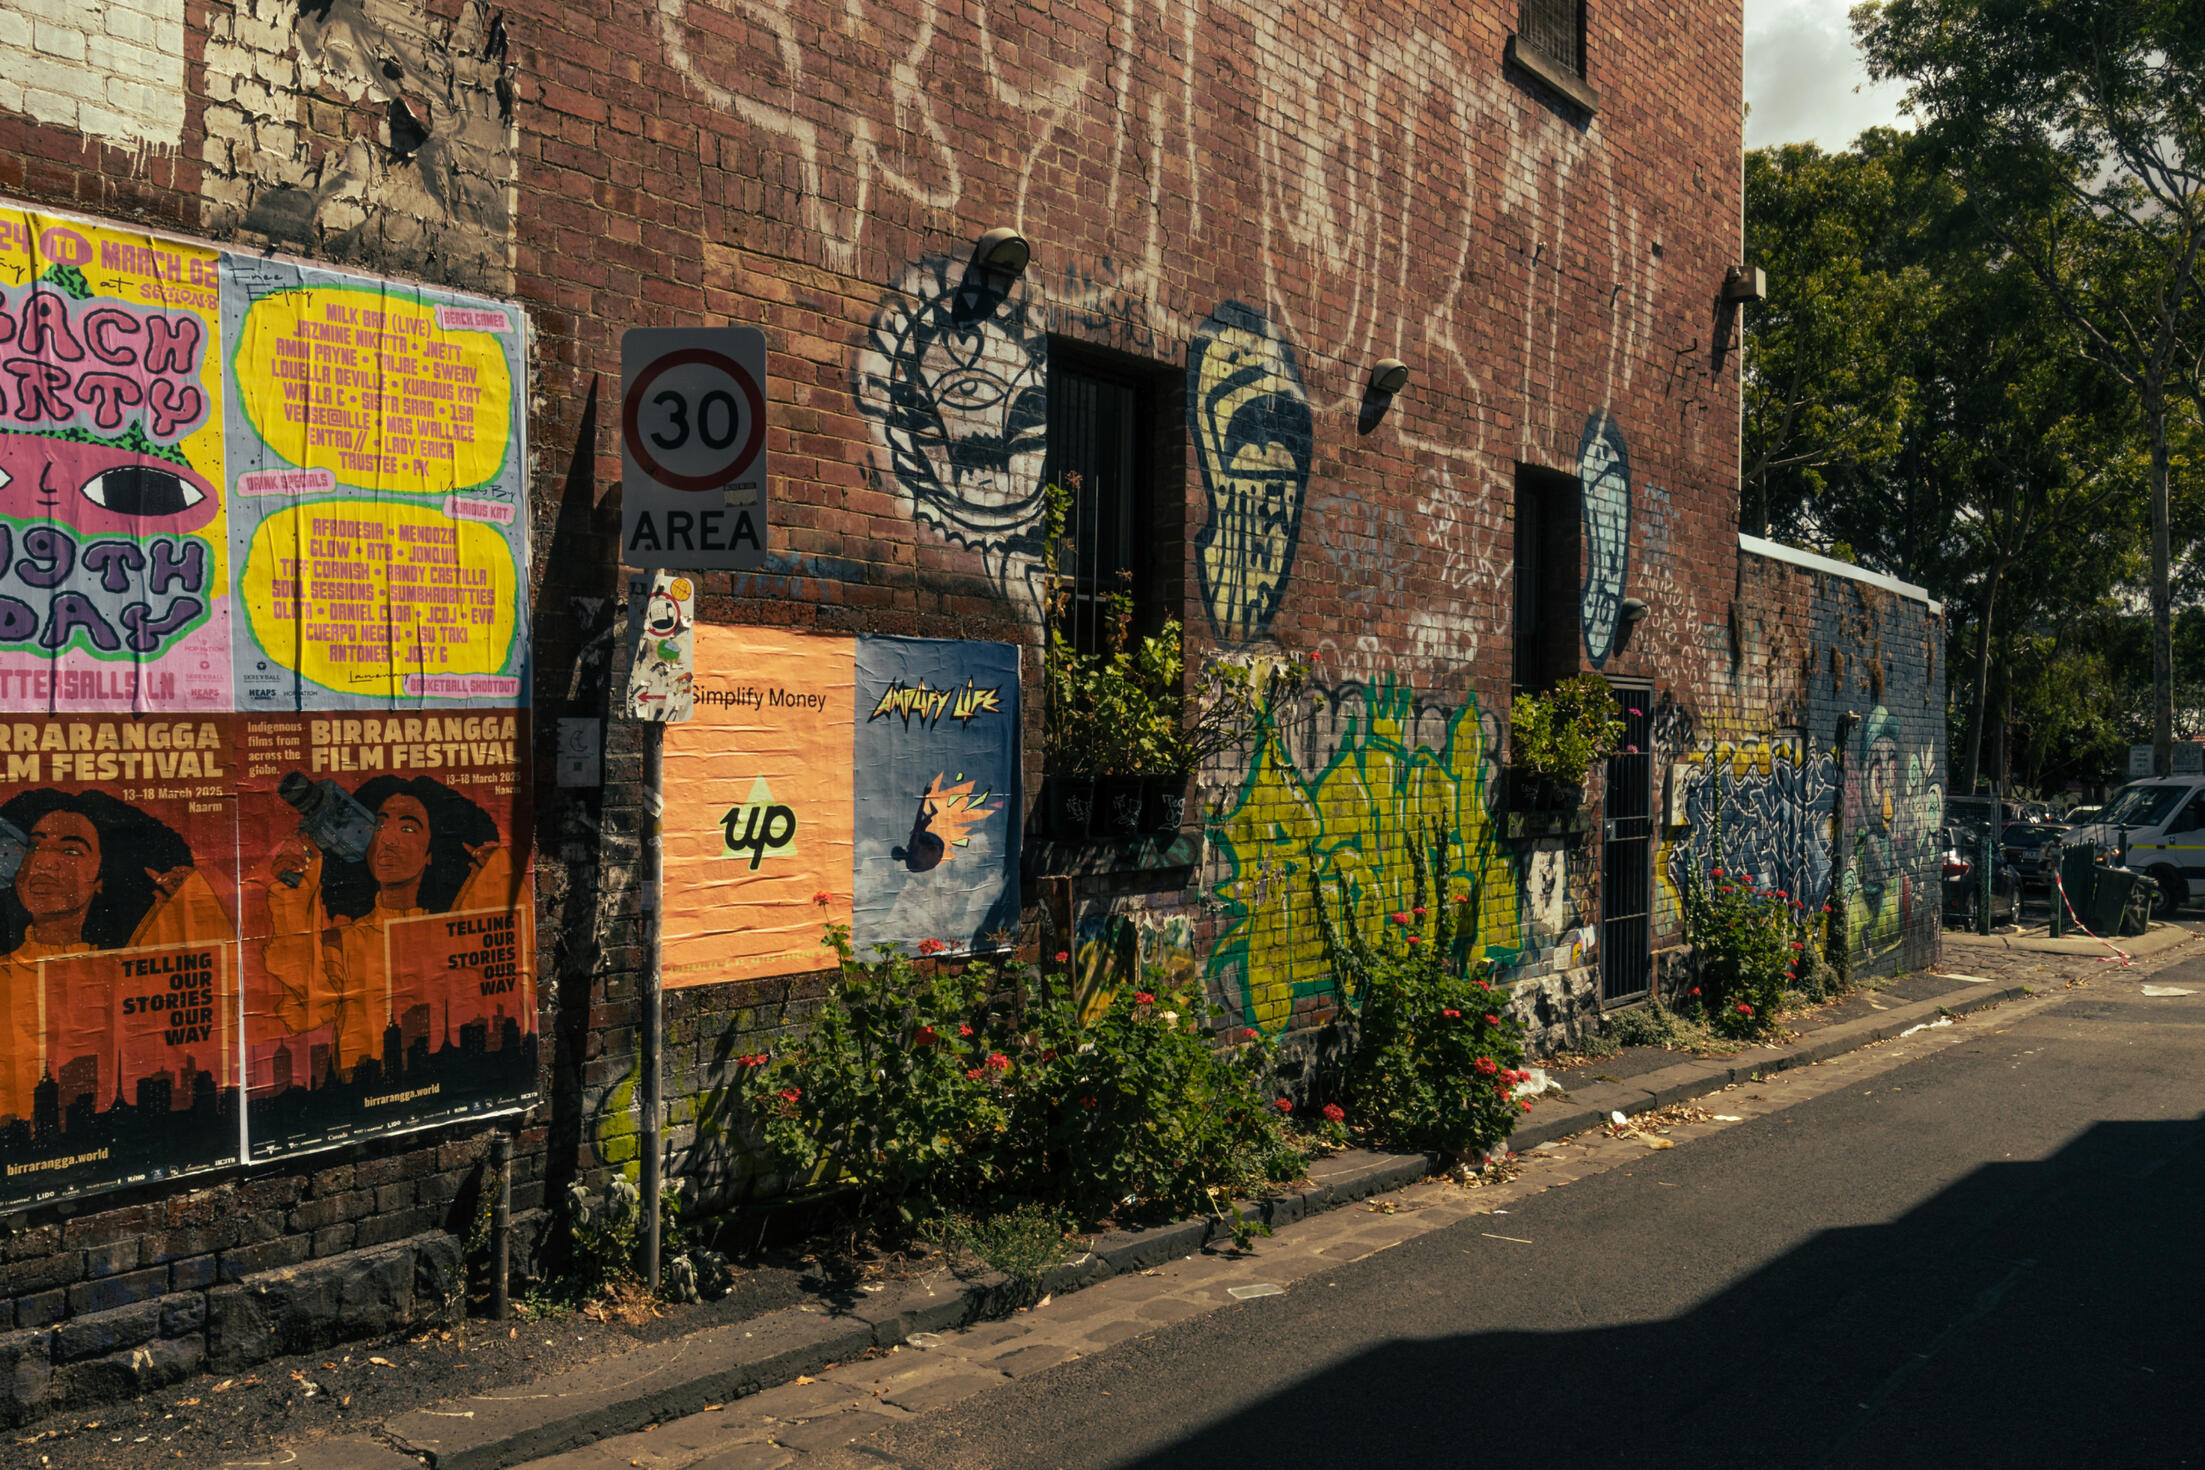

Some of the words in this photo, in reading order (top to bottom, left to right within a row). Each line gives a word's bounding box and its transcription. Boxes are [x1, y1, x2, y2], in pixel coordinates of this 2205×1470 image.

[53, 235, 77, 261] TO
[101, 240, 182, 283] MARCH
[326, 303, 359, 326] MILK
[362, 310, 387, 330] BAR
[392, 314, 431, 339] (LIVE)
[444, 311, 474, 326] BEACH
[475, 313, 505, 328] GAMES
[293, 320, 352, 345] JAZMINE
[355, 329, 408, 354] NIKITTA
[422, 340, 463, 362] JNETT
[276, 337, 311, 360] AMIN
[314, 343, 358, 367] PAYNE
[433, 361, 478, 384] SWERV
[272, 358, 331, 385] LOUELLA
[335, 367, 387, 392] DEVILLE
[402, 377, 454, 401] KURIOUS
[458, 385, 482, 404] KAT
[0, 357, 202, 436] RTY
[283, 381, 332, 405] WALLA
[336, 388, 346, 407] C
[361, 391, 399, 414] SISTA
[403, 397, 435, 418] SARA
[386, 415, 413, 435] MRS
[417, 419, 475, 443] WALLACE
[650, 389, 739, 451] 30
[384, 435, 416, 456] LADY
[420, 439, 455, 460] ERICA
[338, 451, 398, 475] TRUSTEE
[413, 459, 430, 477] PK
[246, 475, 278, 491] DRINK
[280, 473, 328, 490] SPECIALS
[488, 484, 516, 503] By
[452, 502, 488, 518] KURIOUS
[490, 506, 509, 520] KAT
[312, 518, 384, 540] AFRODESIA
[398, 523, 457, 545] MENDOZA
[628, 510, 762, 552] AREA
[310, 538, 351, 559] GLOW
[408, 545, 459, 565] JONQUIL
[279, 558, 309, 577] TIFF
[313, 560, 370, 581] CORNISH
[386, 563, 426, 583] RANDY
[429, 566, 487, 586] CASTILLA
[271, 579, 307, 599] SOUL
[310, 581, 375, 601] SESSIONS
[329, 602, 375, 622] DANIEL
[471, 607, 495, 625] EVA
[305, 622, 357, 642] CUERPO
[361, 624, 401, 643] NEGRO
[420, 625, 436, 644] SU
[439, 626, 468, 644] TAKI
[329, 644, 390, 663] ANTONES
[404, 645, 436, 664] JOEY
[439, 646, 448, 663] G
[152, 671, 175, 700] LN
[249, 689, 277, 697] HEAPS
[410, 678, 468, 693] BASKETBALL
[470, 679, 517, 693] SHOOTOUT
[693, 685, 764, 711] Simplify
[769, 688, 827, 712] Money
[867, 675, 956, 734] AMPLIFY
[247, 721, 303, 735] Indigenous
[311, 716, 519, 746] BIRRARANGGA
[247, 735, 274, 747] films
[276, 735, 301, 746] from
[52, 751, 224, 782] FESTIVAL
[248, 751, 282, 762] across
[284, 748, 301, 760] the
[312, 744, 385, 773] FILM
[392, 740, 522, 769] FESTIVAL
[248, 764, 281, 778] globe.
[472, 772, 498, 784] March
[499, 771, 521, 783] 2025
[158, 787, 193, 800] March
[195, 786, 223, 798] 2025
[188, 801, 223, 813] Naarm
[719, 803, 798, 872] up
[445, 914, 515, 938] TELLING
[482, 931, 516, 948] OUR
[121, 953, 213, 978] TELLING
[448, 946, 516, 970] STORIES
[169, 971, 213, 991] OUR
[484, 962, 517, 980] OUR
[480, 977, 517, 997] WAY
[122, 988, 214, 1015] STORIES
[170, 1007, 213, 1028] OUR
[164, 1024, 213, 1046] WAY
[364, 1083, 440, 1108] birrarangga.world
[327, 1131, 349, 1141] Canada
[6, 1147, 109, 1177] birrarangga.world
[36, 1191, 56, 1200] LIDO
